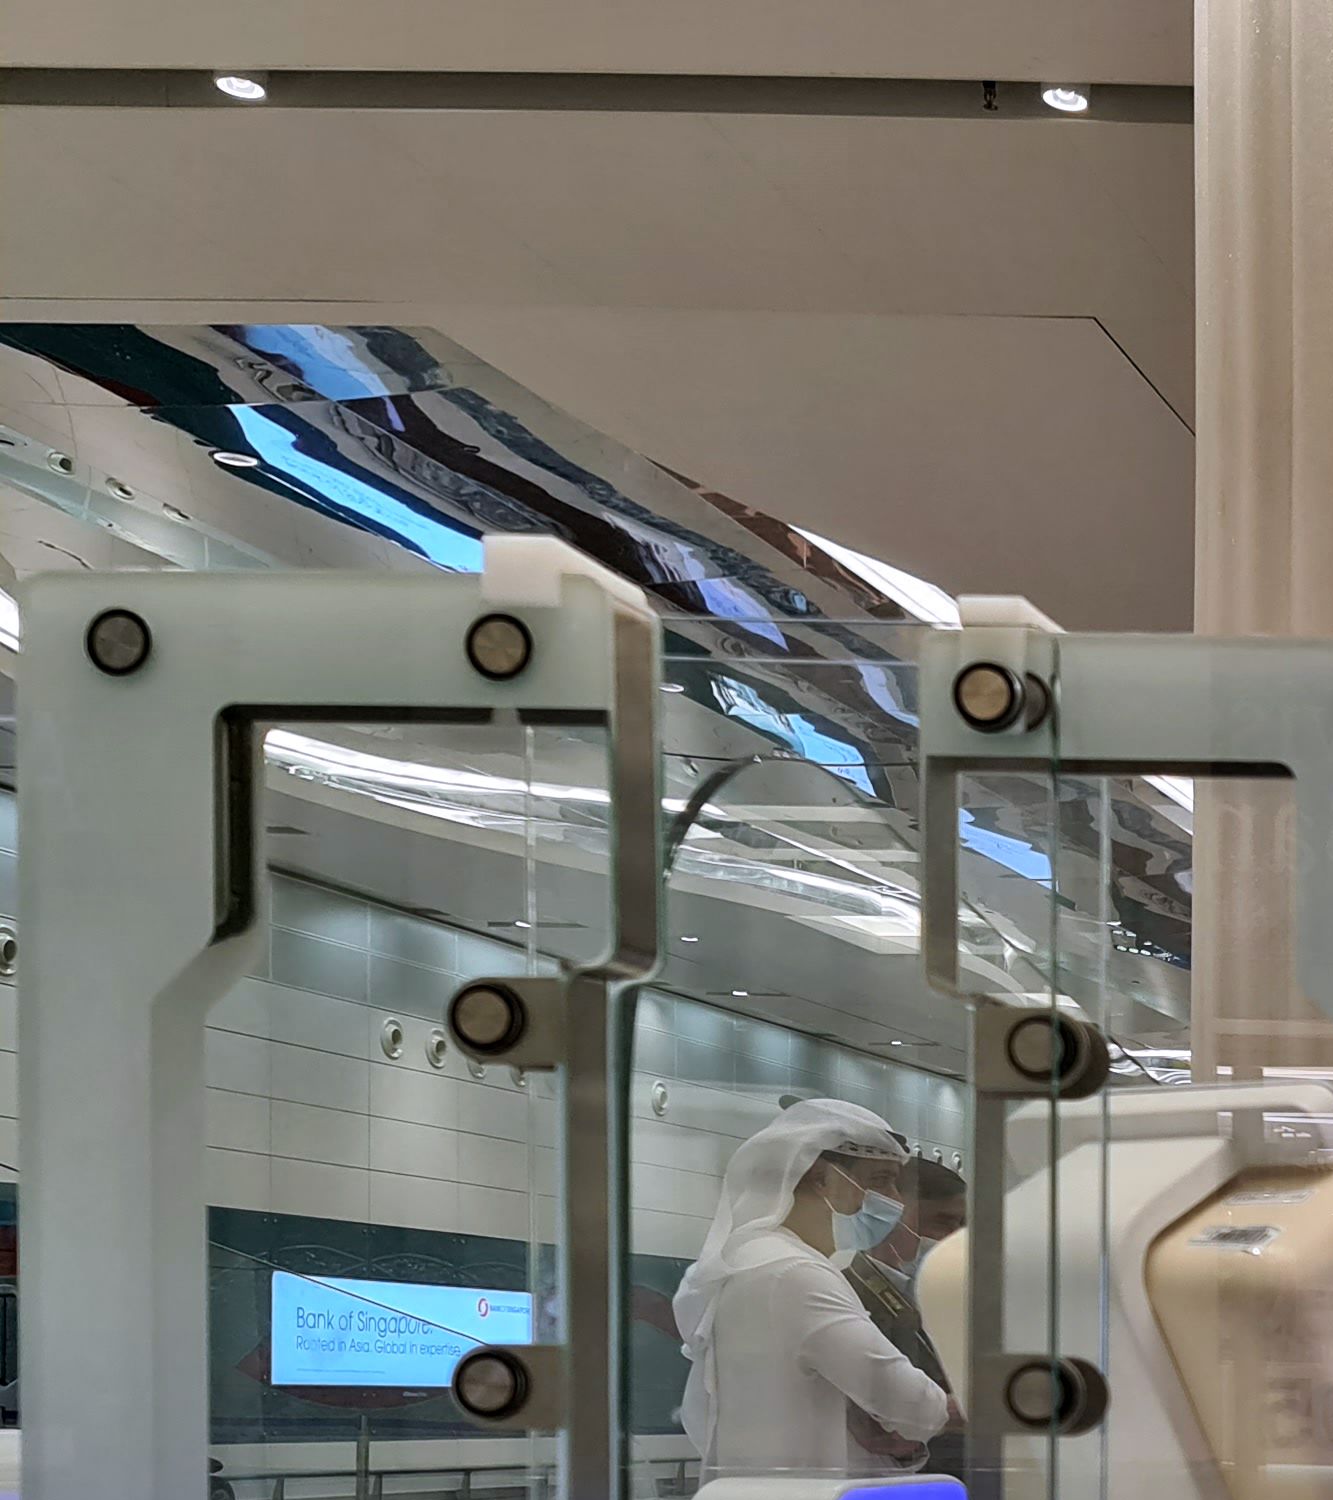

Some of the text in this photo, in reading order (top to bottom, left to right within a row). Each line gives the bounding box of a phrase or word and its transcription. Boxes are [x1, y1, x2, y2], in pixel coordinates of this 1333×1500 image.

[296, 1306, 334, 1330] Bank
[338, 1310, 354, 1331] of
[374, 1339, 407, 1354] Global
